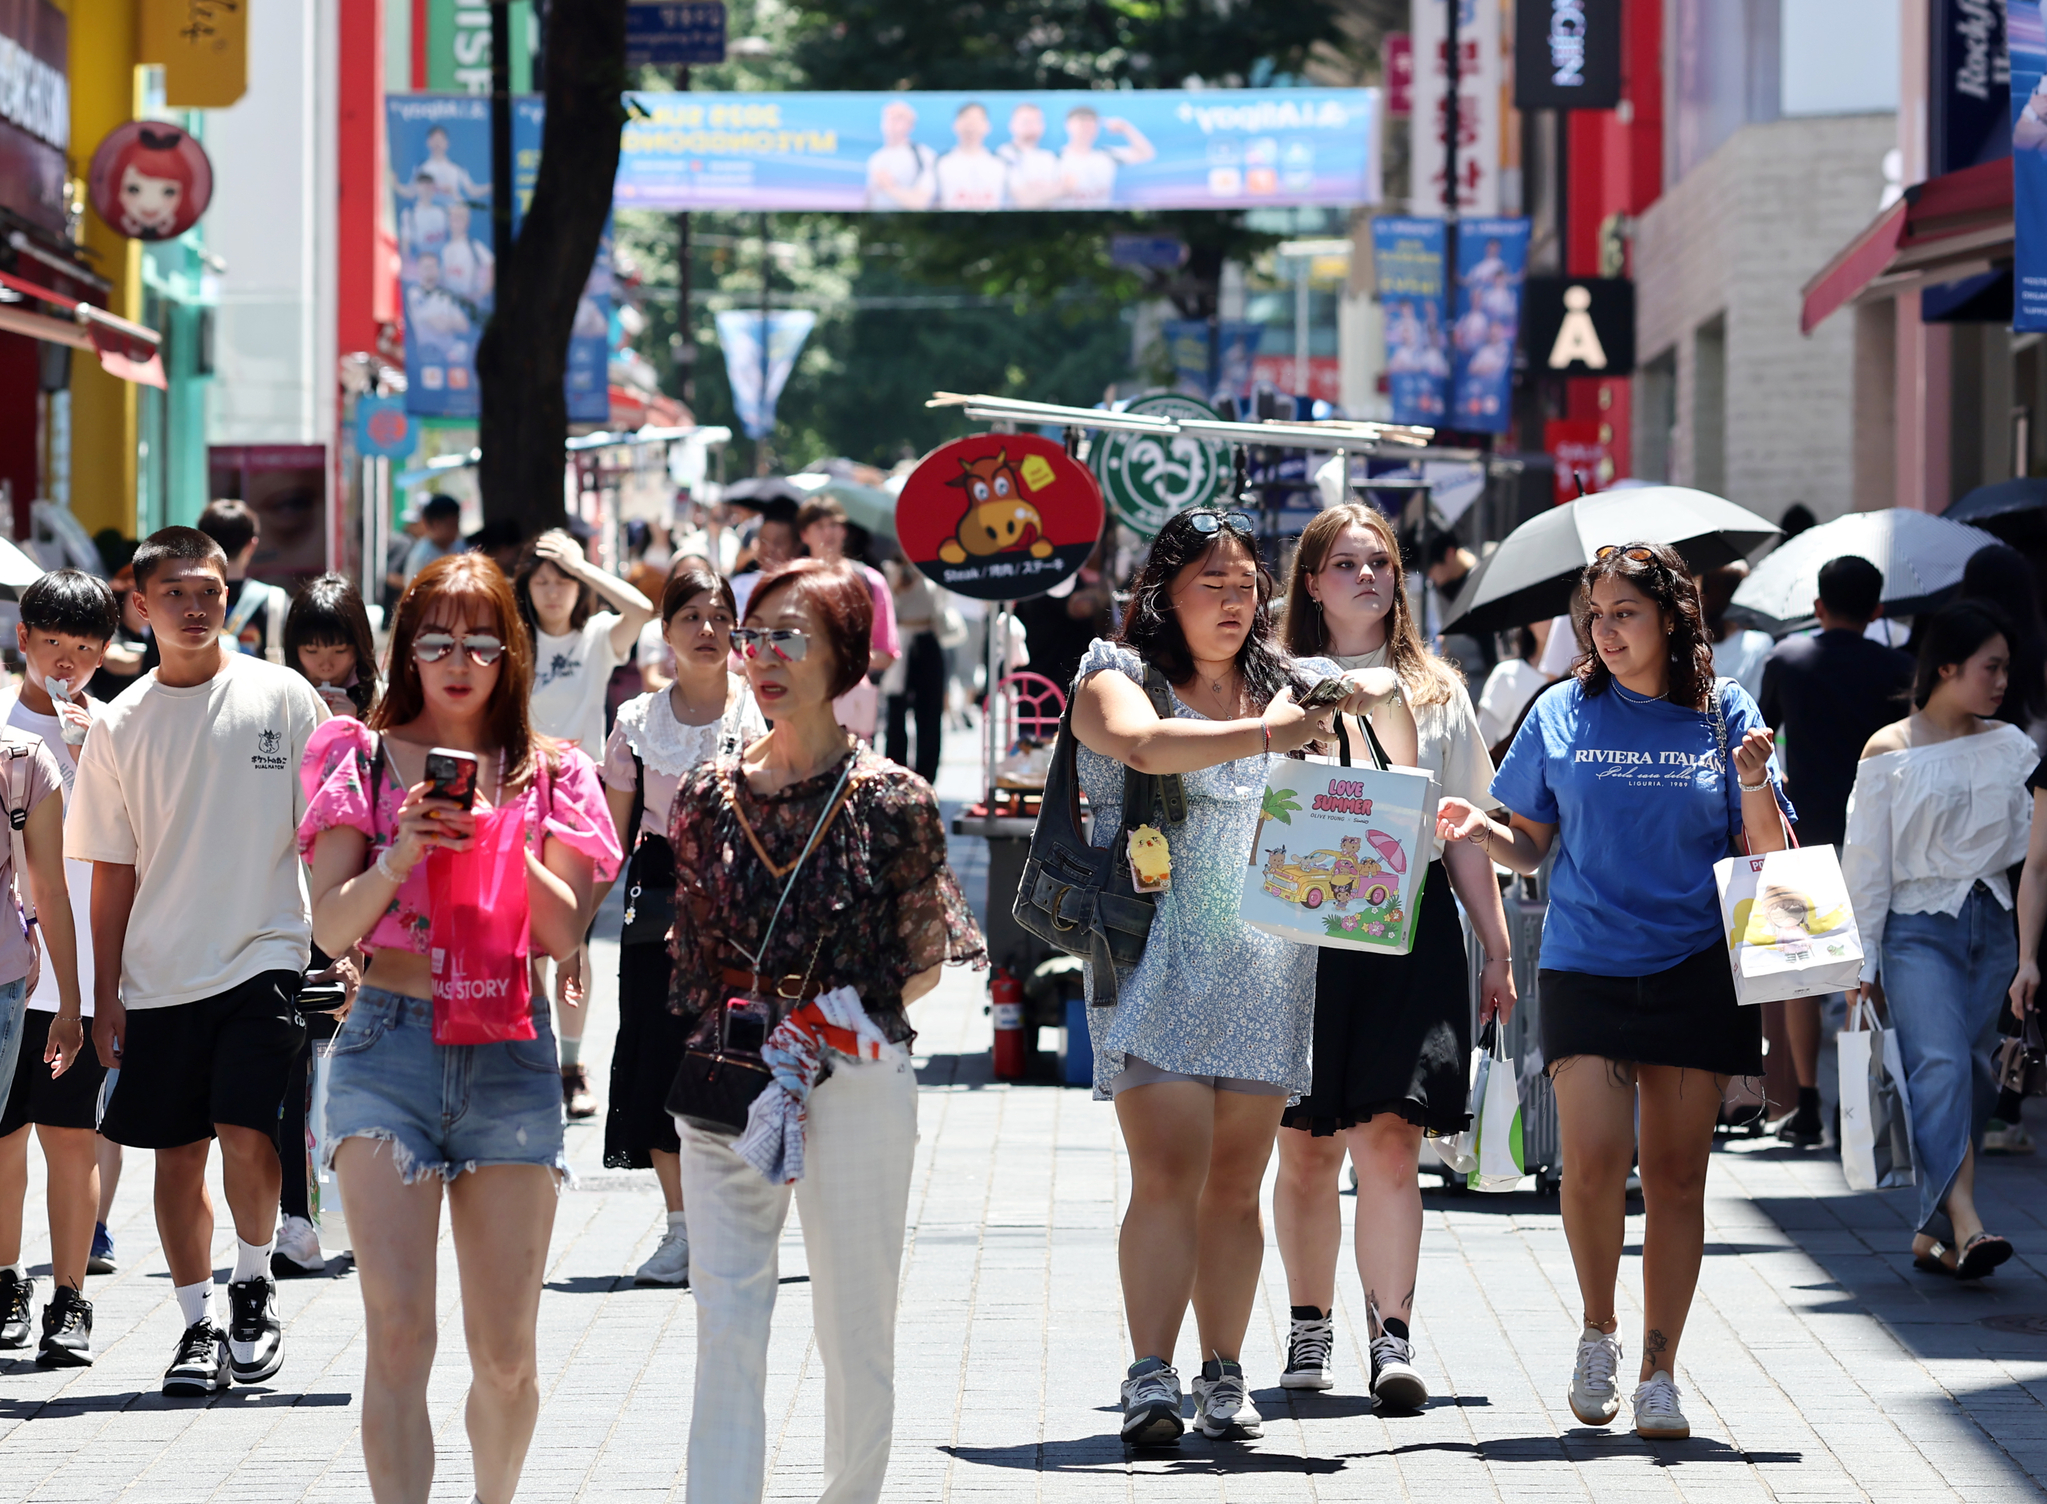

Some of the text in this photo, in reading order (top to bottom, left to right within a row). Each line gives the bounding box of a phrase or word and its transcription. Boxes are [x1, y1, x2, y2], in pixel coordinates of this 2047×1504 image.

[943, 567, 979, 582] Steak
[1574, 749, 1654, 765] RIVIERA
[1328, 779, 1364, 798] LOVE
[1311, 794, 1373, 816] SUMMER
[456, 978, 510, 999] STORY
